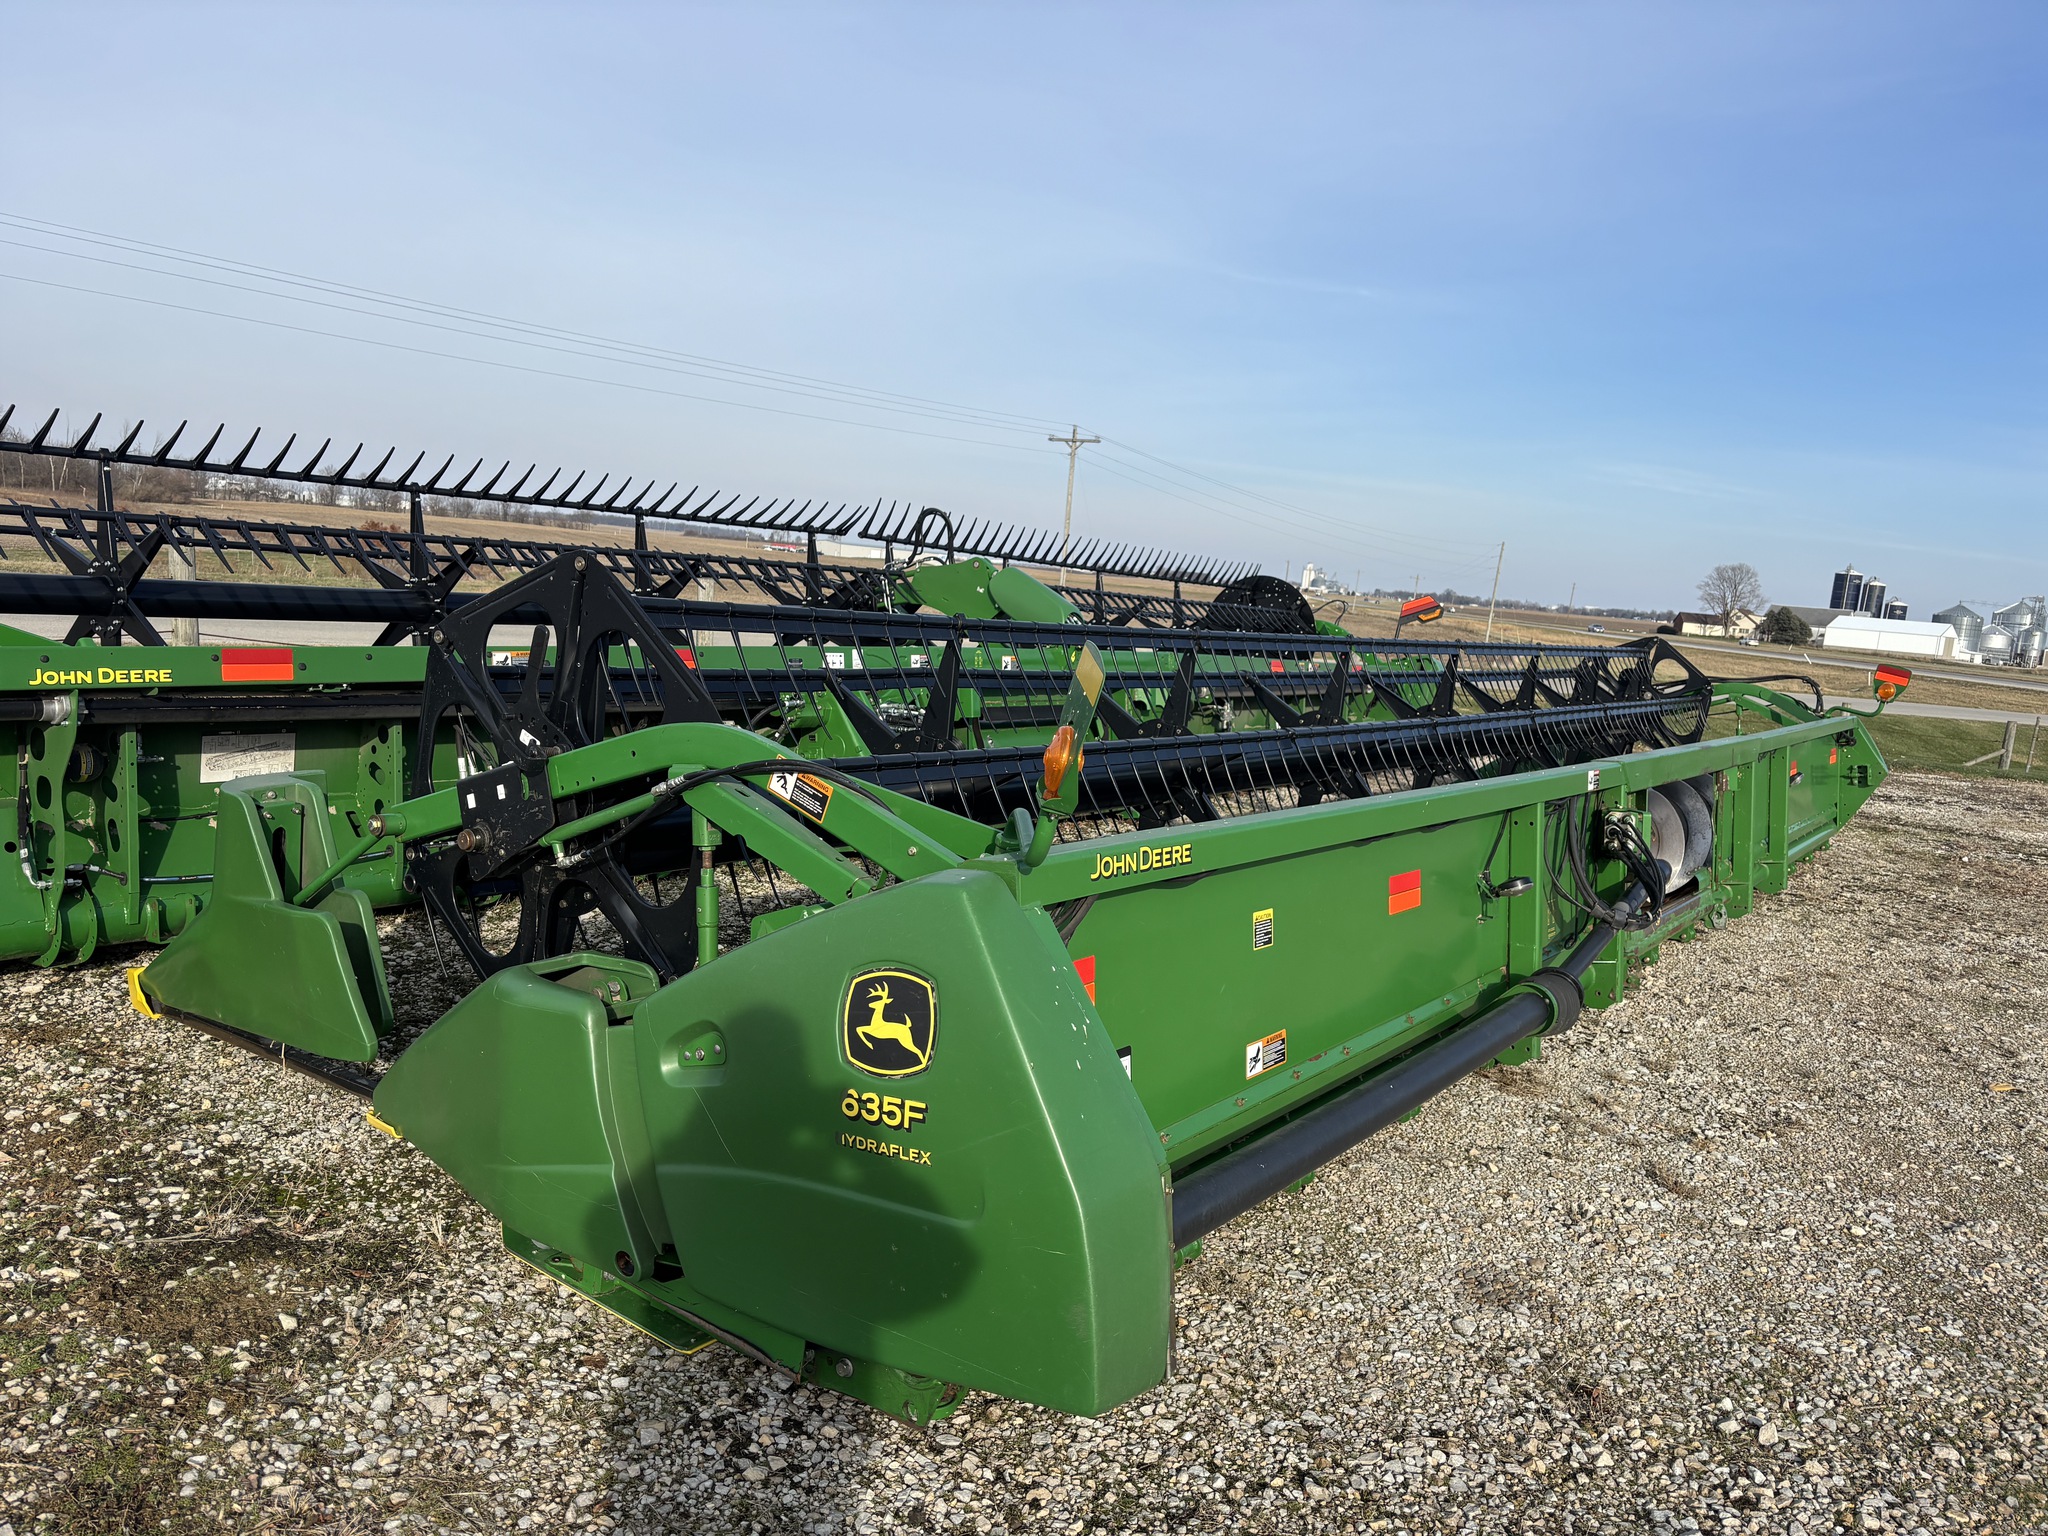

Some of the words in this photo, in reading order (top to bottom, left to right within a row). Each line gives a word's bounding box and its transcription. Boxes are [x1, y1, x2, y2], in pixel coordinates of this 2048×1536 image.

[28, 668, 93, 686] JOHN
[97, 667, 173, 683] DEERE
[1090, 853, 1137, 880] JOHN
[1139, 844, 1192, 872] DEERE
[841, 1088, 927, 1132] 635F
